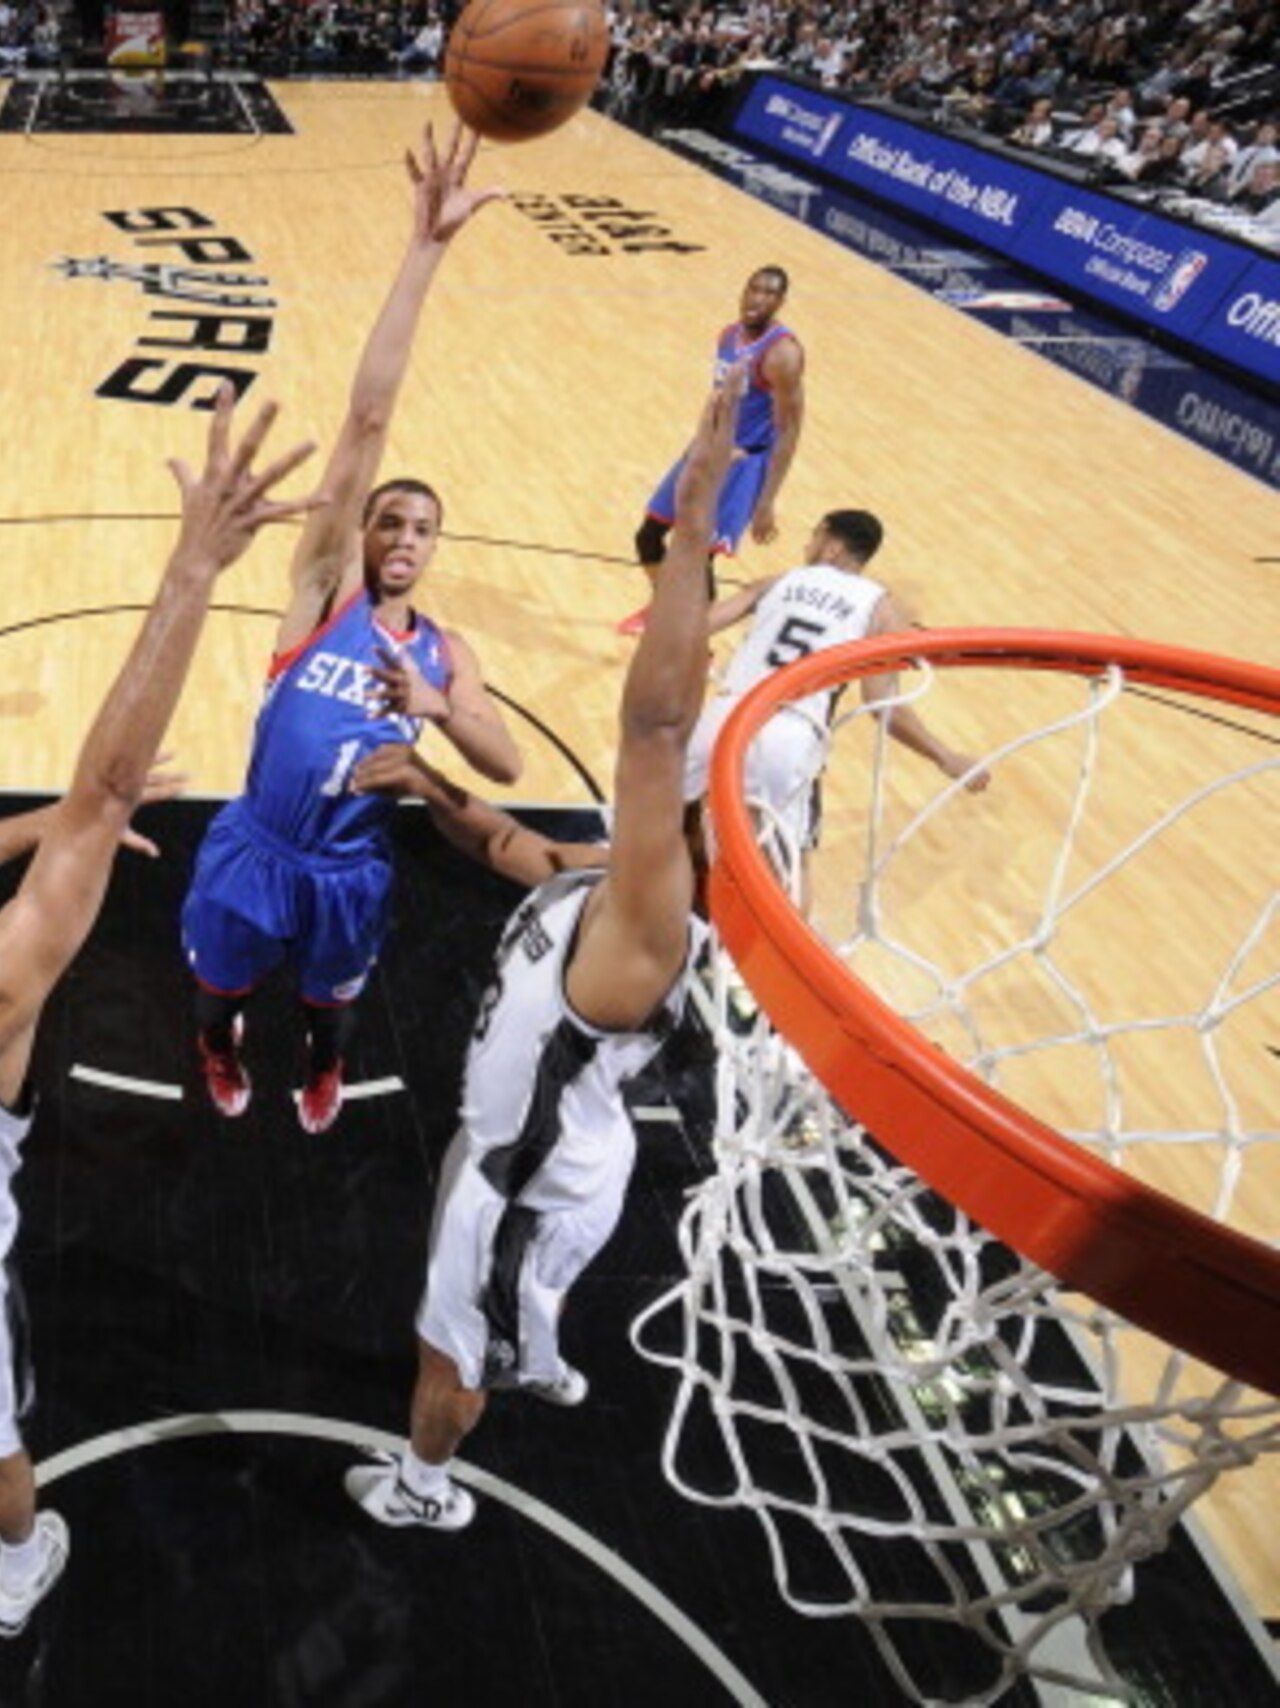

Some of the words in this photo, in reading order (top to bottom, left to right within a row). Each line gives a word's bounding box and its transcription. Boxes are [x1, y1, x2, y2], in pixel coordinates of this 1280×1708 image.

[847, 132, 896, 173] Official
[890, 148, 936, 188] Bank
[928, 167, 957, 195] of
[946, 174, 980, 208] the
[1093, 223, 1172, 274] Compass
[95, 206, 278, 412] SPURS
[766, 615, 827, 668] 5
